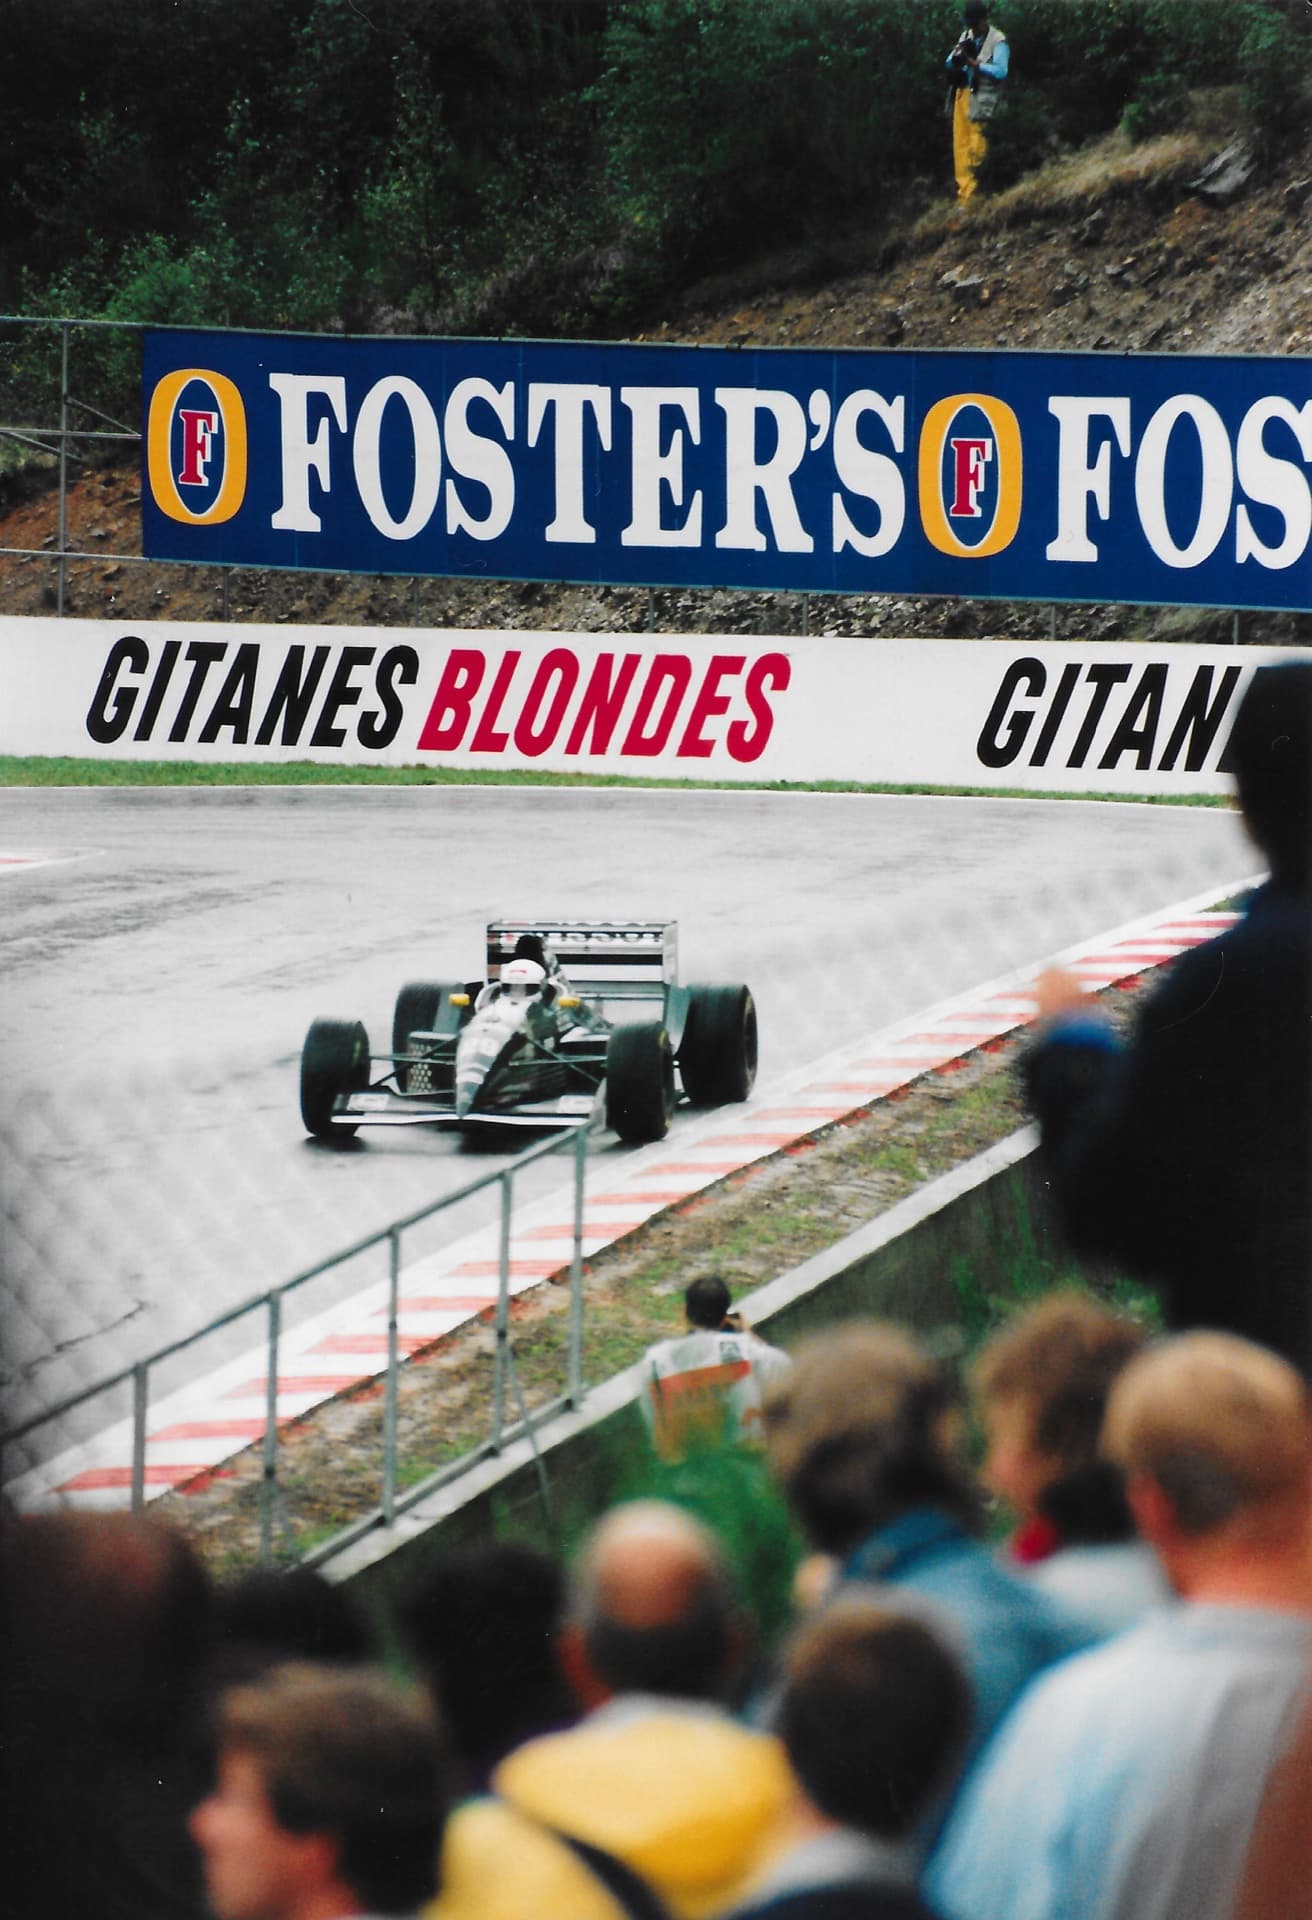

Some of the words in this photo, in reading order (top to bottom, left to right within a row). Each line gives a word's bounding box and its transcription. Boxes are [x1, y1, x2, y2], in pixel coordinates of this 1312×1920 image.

[269, 372, 906, 557] FOSTER'S
[1046, 395, 1312, 570] FOS
[87, 636, 419, 749] GITANES
[417, 648, 792, 763] BLONDES
[977, 657, 1254, 773] GITAN
